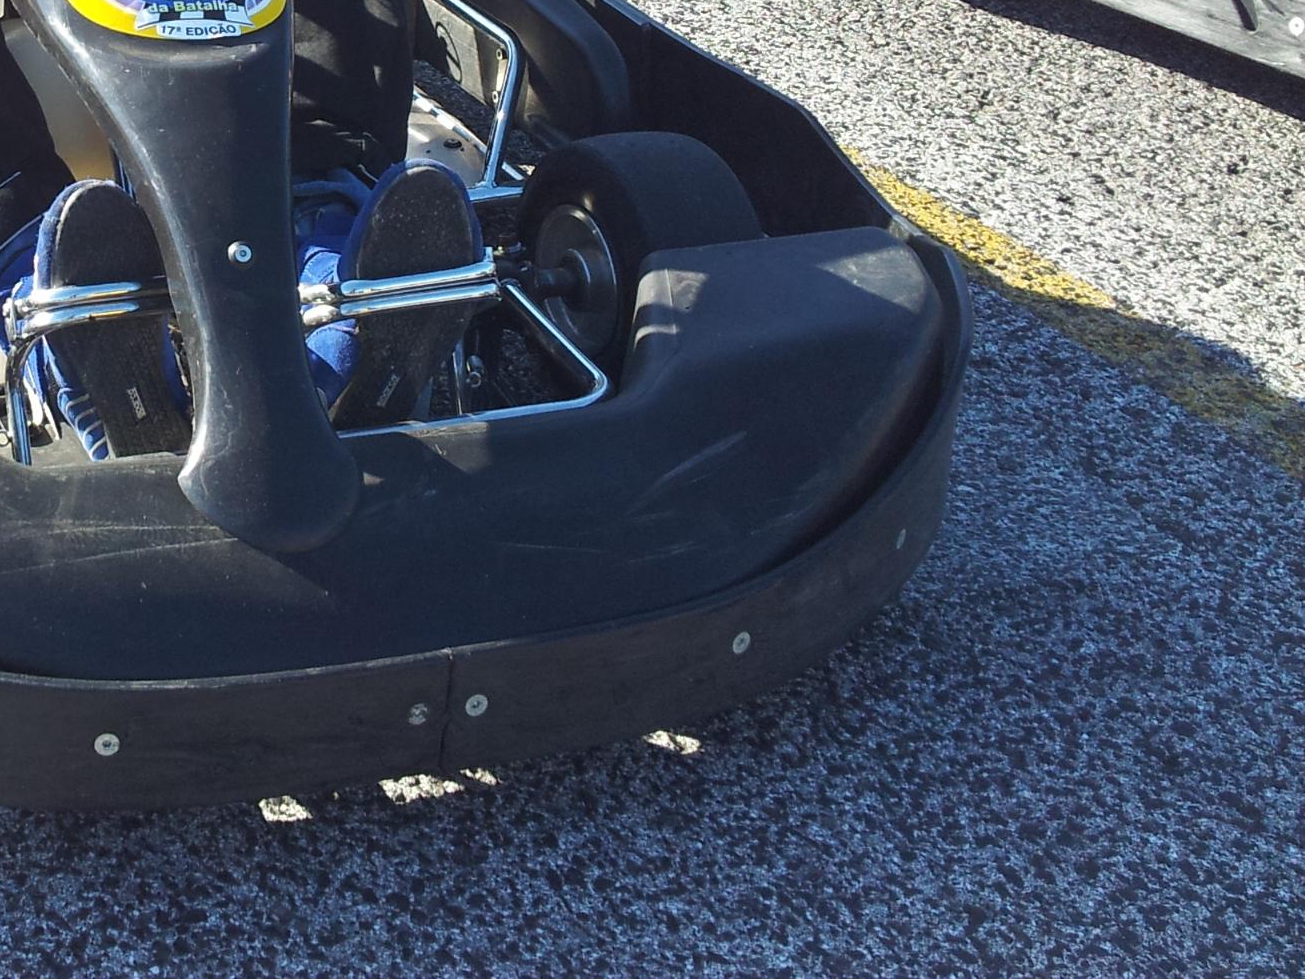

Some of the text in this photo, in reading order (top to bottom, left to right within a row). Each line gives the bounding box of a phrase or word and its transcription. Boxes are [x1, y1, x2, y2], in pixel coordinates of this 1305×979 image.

[148, 0, 239, 14] da Batalha
[186, 23, 237, 37] EDIÇÃO
